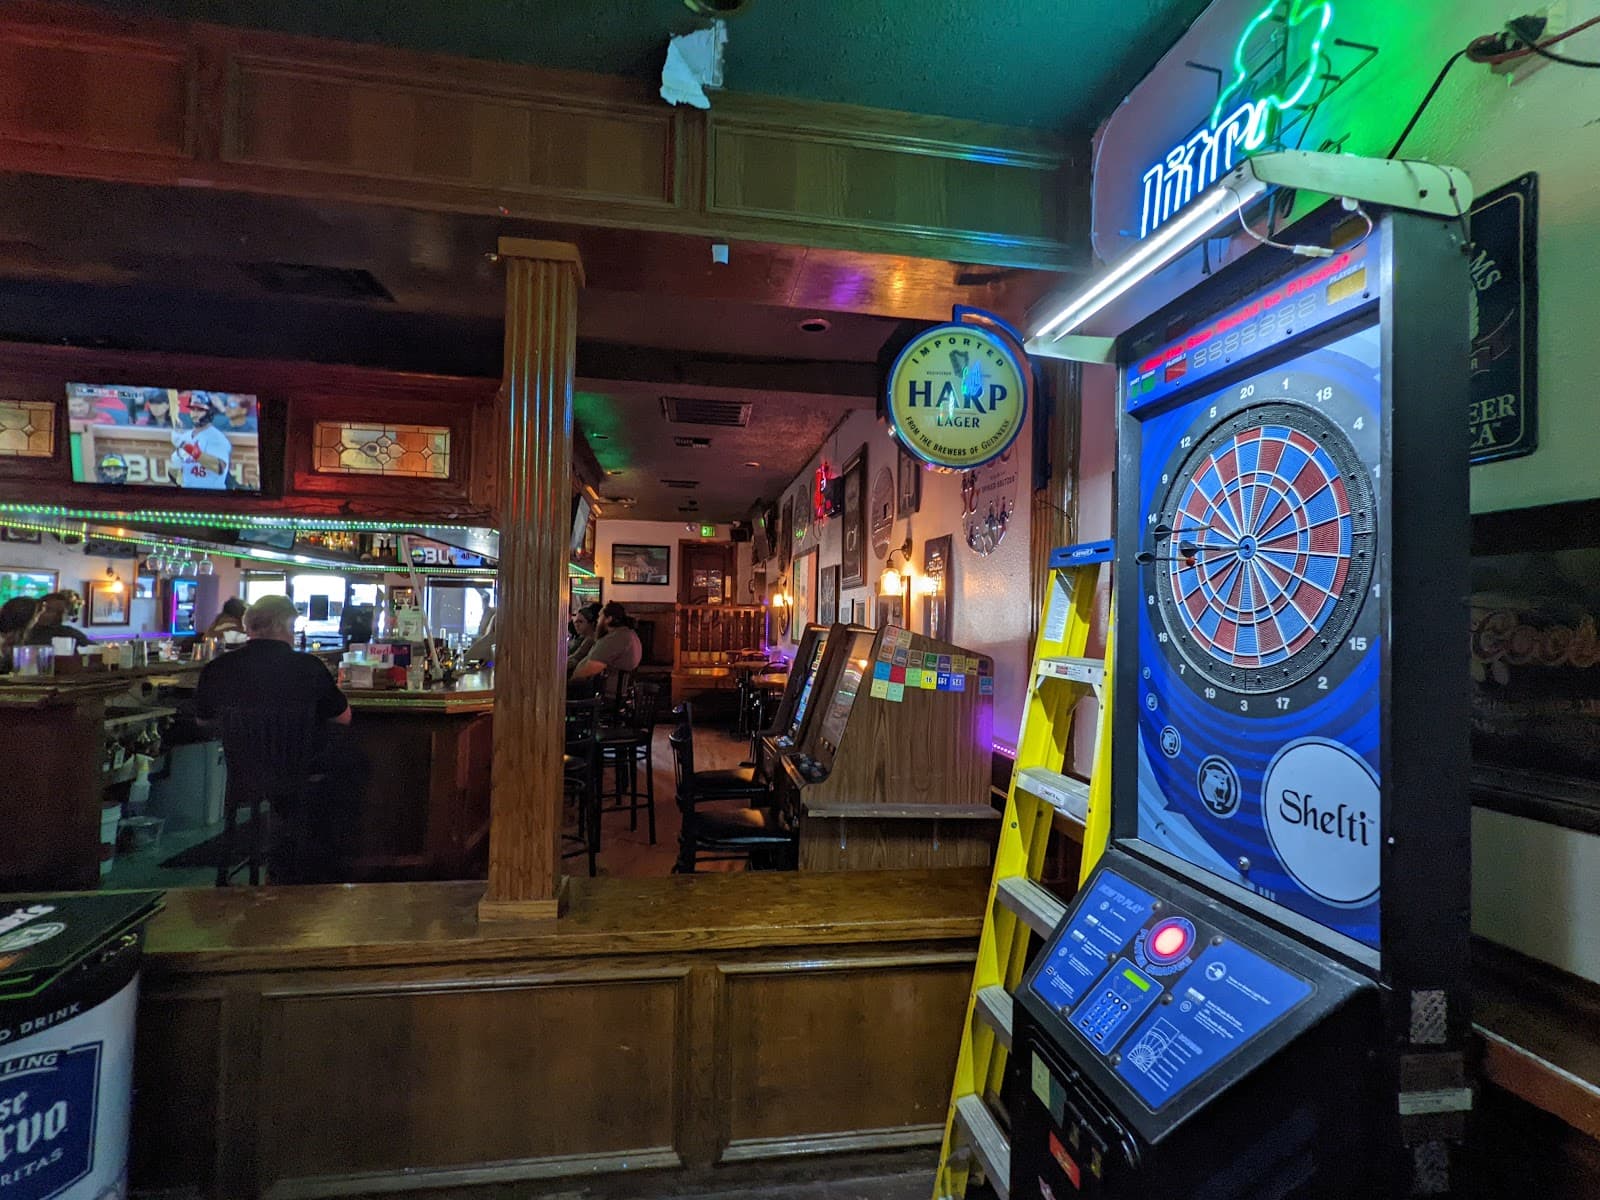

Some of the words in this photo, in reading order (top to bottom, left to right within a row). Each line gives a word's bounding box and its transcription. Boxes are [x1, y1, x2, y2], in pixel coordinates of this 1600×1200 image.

[912, 337, 1004, 367] IMPORTED
[1282, 377, 1289, 391] 1
[908, 380, 1008, 414] HARP
[1239, 384, 1255, 400] 20
[1315, 386, 1333, 402] 18
[1209, 406, 1217, 418] 5
[937, 416, 980, 429] LAGER
[1353, 416, 1364, 431] 4
[905, 416, 921, 437] FROM
[919, 433, 933, 448] THE
[933, 443, 967, 457] BREWERS
[969, 445, 979, 455] OF
[981, 419, 1010, 450] GUINNESS
[1180, 436, 1192, 449] 12
[1161, 473, 1169, 485] 9
[1147, 512, 1157, 524] 14
[1148, 594, 1155, 605] 8
[1158, 631, 1168, 643] 16
[1350, 636, 1368, 651] 15
[1179, 663, 1186, 675] 7
[1317, 676, 1329, 690] 2
[1204, 686, 1217, 700] 19
[1240, 699, 1249, 712] 3
[1276, 697, 1290, 711] 17
[1279, 788, 1369, 847] Shelti
[20, 1002, 80, 1035] DRINK
[4, 1053, 59, 1074] LING
[0, 1091, 28, 1117] se
[0, 1100, 67, 1162] rvo
[1, 1147, 64, 1186] RITAS
